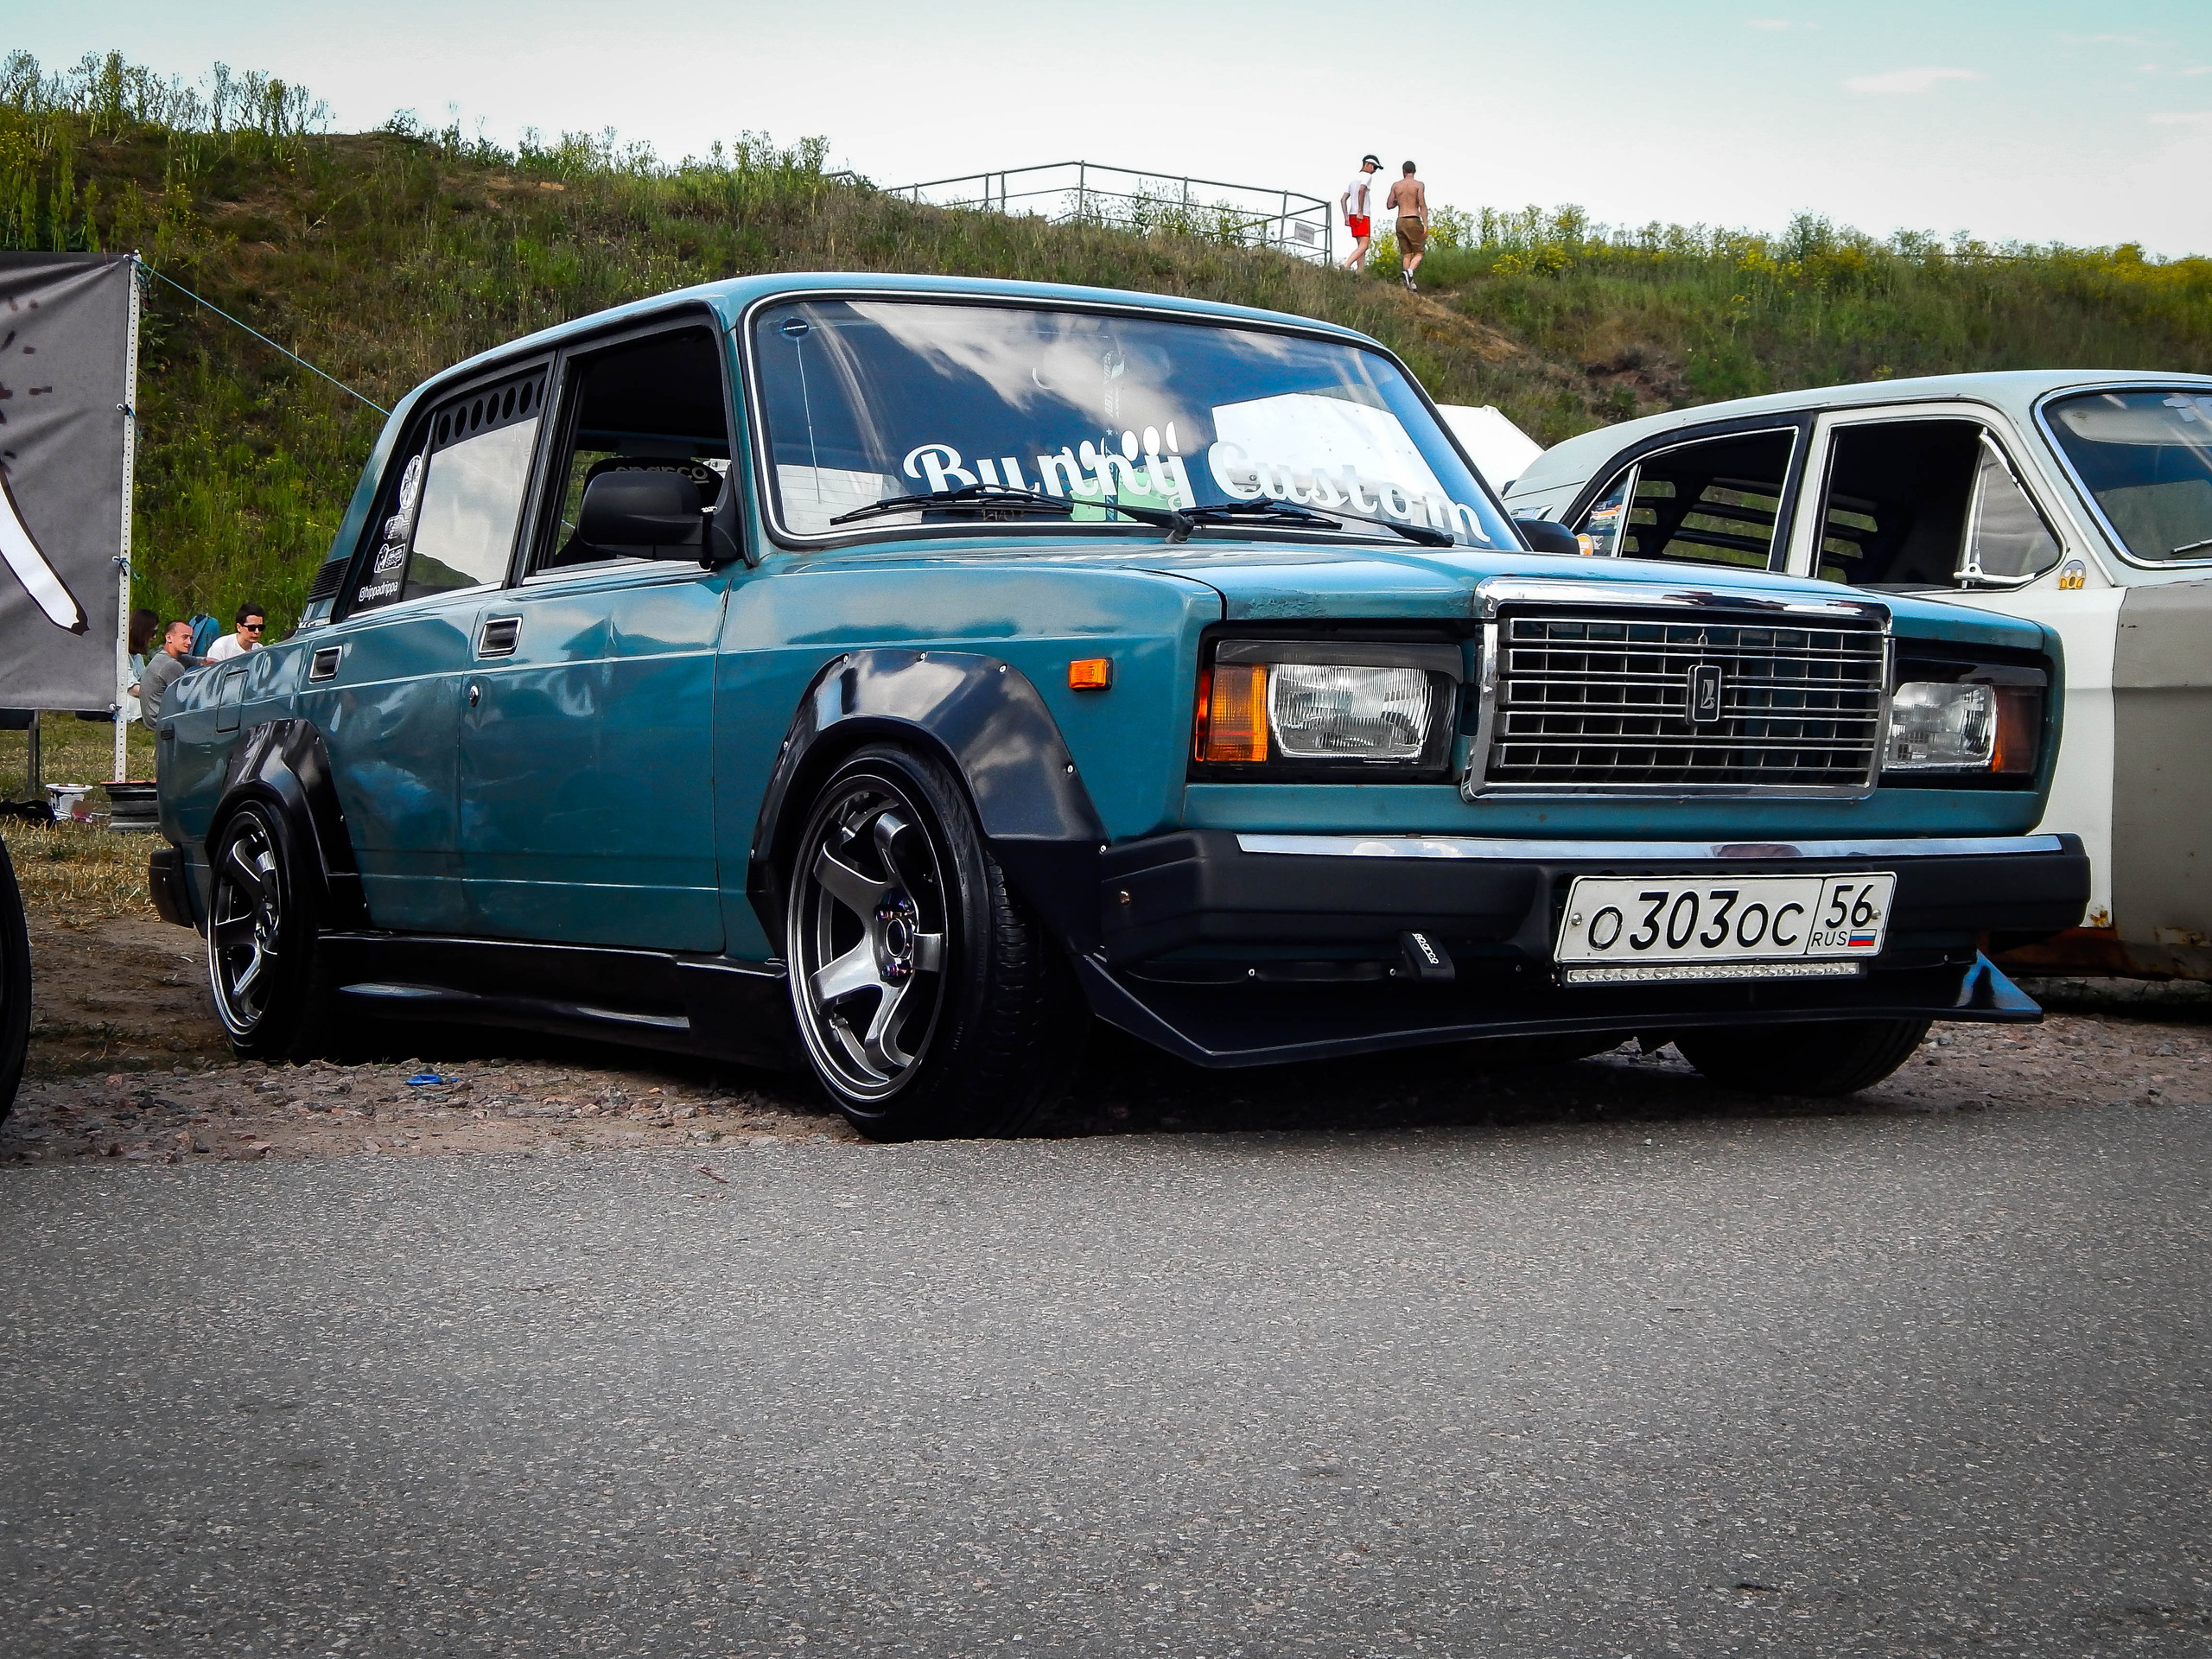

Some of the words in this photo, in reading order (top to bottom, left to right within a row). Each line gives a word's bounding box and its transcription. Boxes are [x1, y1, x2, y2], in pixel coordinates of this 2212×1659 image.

[903, 442, 1198, 512] Bunny
[1208, 442, 1491, 543] Custom
[1825, 884, 1875, 929] 56
[1811, 930, 1847, 947] RUS
